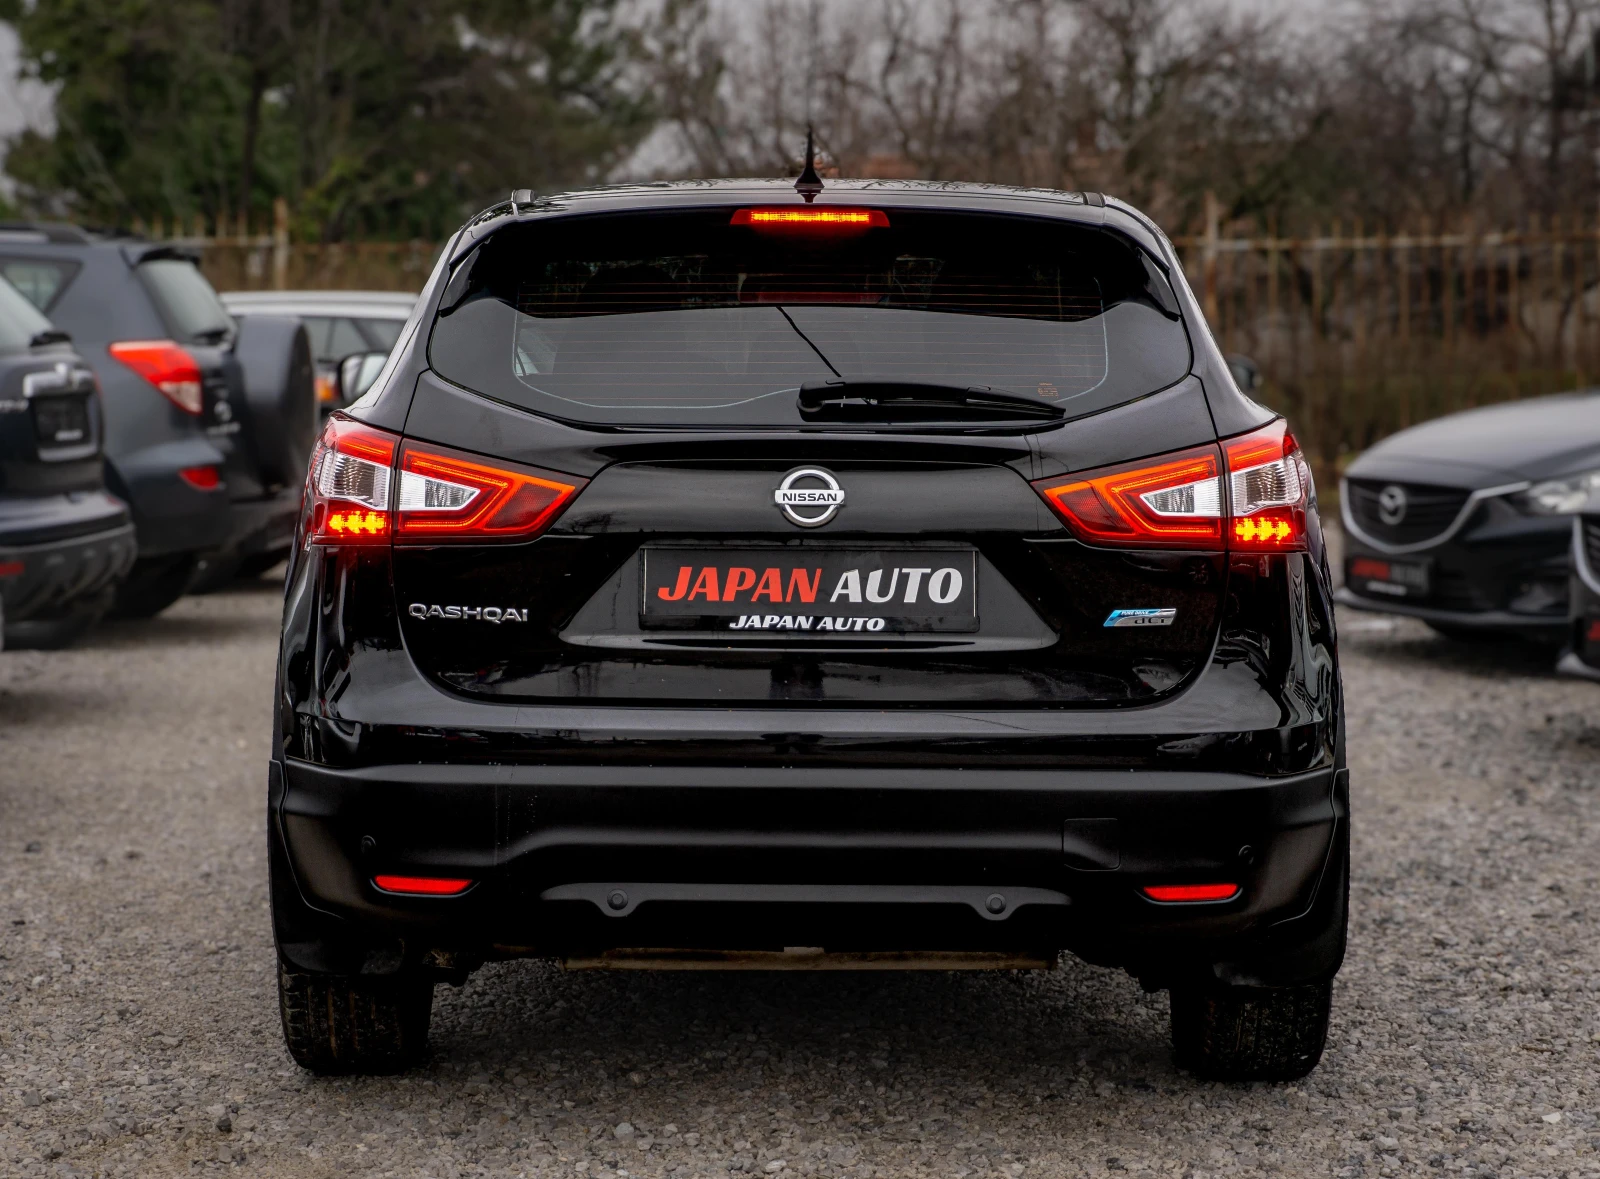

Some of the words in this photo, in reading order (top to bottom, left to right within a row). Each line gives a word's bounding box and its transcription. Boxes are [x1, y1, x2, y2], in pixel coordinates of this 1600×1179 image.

[782, 492, 837, 502] NISSAN
[657, 566, 822, 603] JAPAN
[830, 567, 963, 604] AUTO
[408, 603, 529, 624] QASHQAI
[729, 615, 814, 630] JAPAN
[816, 617, 885, 631] AUTO
